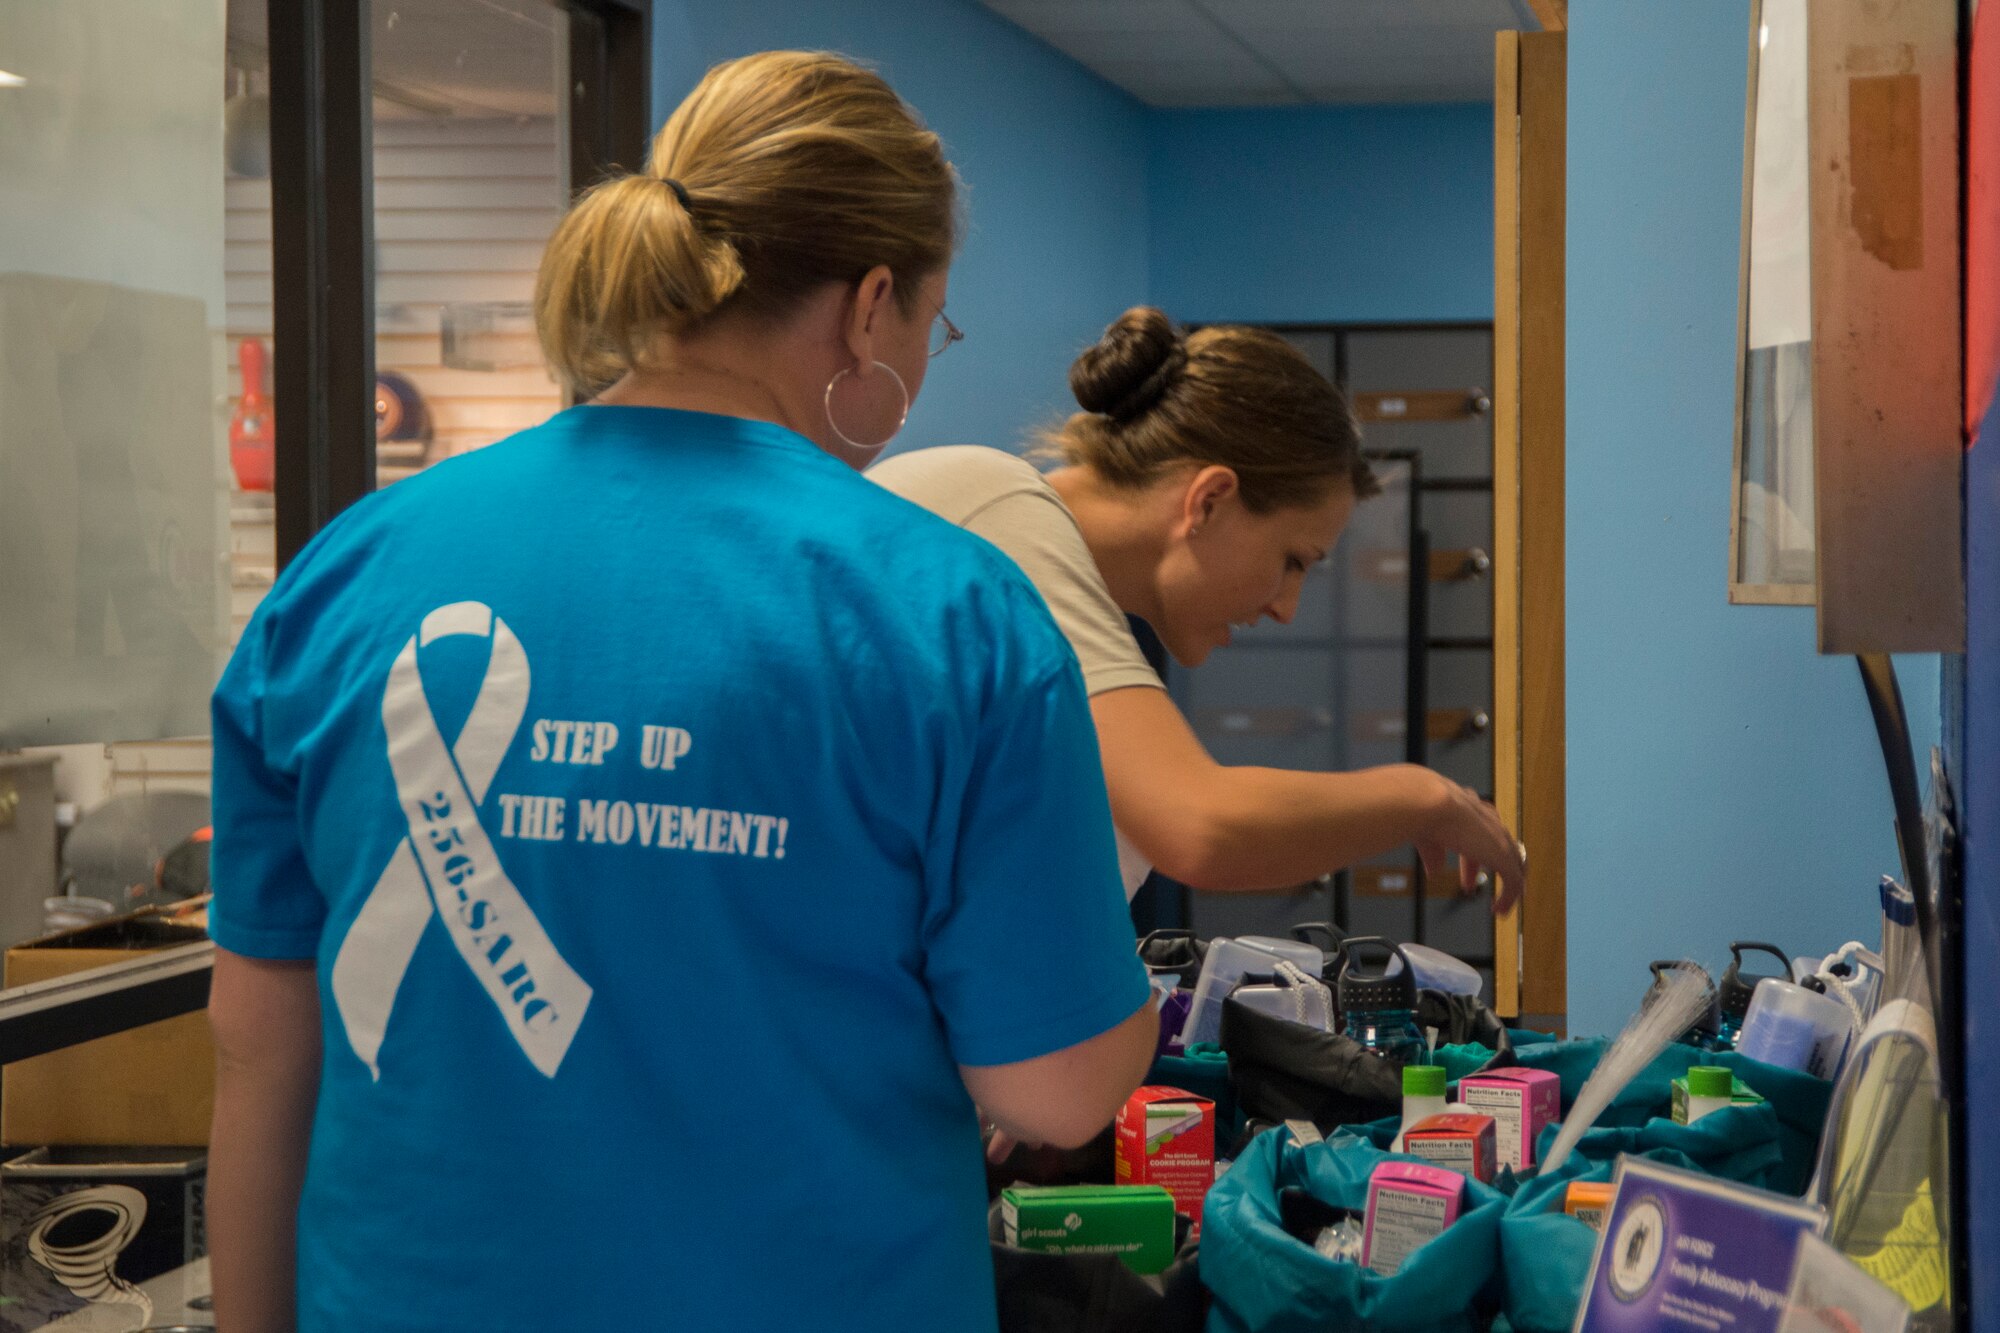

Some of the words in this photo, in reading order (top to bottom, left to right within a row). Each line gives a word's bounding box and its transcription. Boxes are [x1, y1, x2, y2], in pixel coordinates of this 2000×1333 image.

[531, 719, 619, 766] STEP
[640, 724, 692, 770] UP
[499, 794, 566, 841] THE
[577, 799, 790, 859] MOVEMENT!
[418, 790, 560, 1033] 256-SARC
[1467, 1088, 1499, 1097] Nutrition
[1411, 1141, 1447, 1149] Nutrition
[1449, 1141, 1472, 1149] Facts
[1149, 1159, 1176, 1167] COOKIE
[1176, 1159, 1211, 1167] PROGRAM
[1379, 1190, 1418, 1203] Nutrition
[1420, 1196, 1445, 1208] Facts
[1021, 1229, 1037, 1240] girl
[1038, 1229, 1067, 1237] scouts
